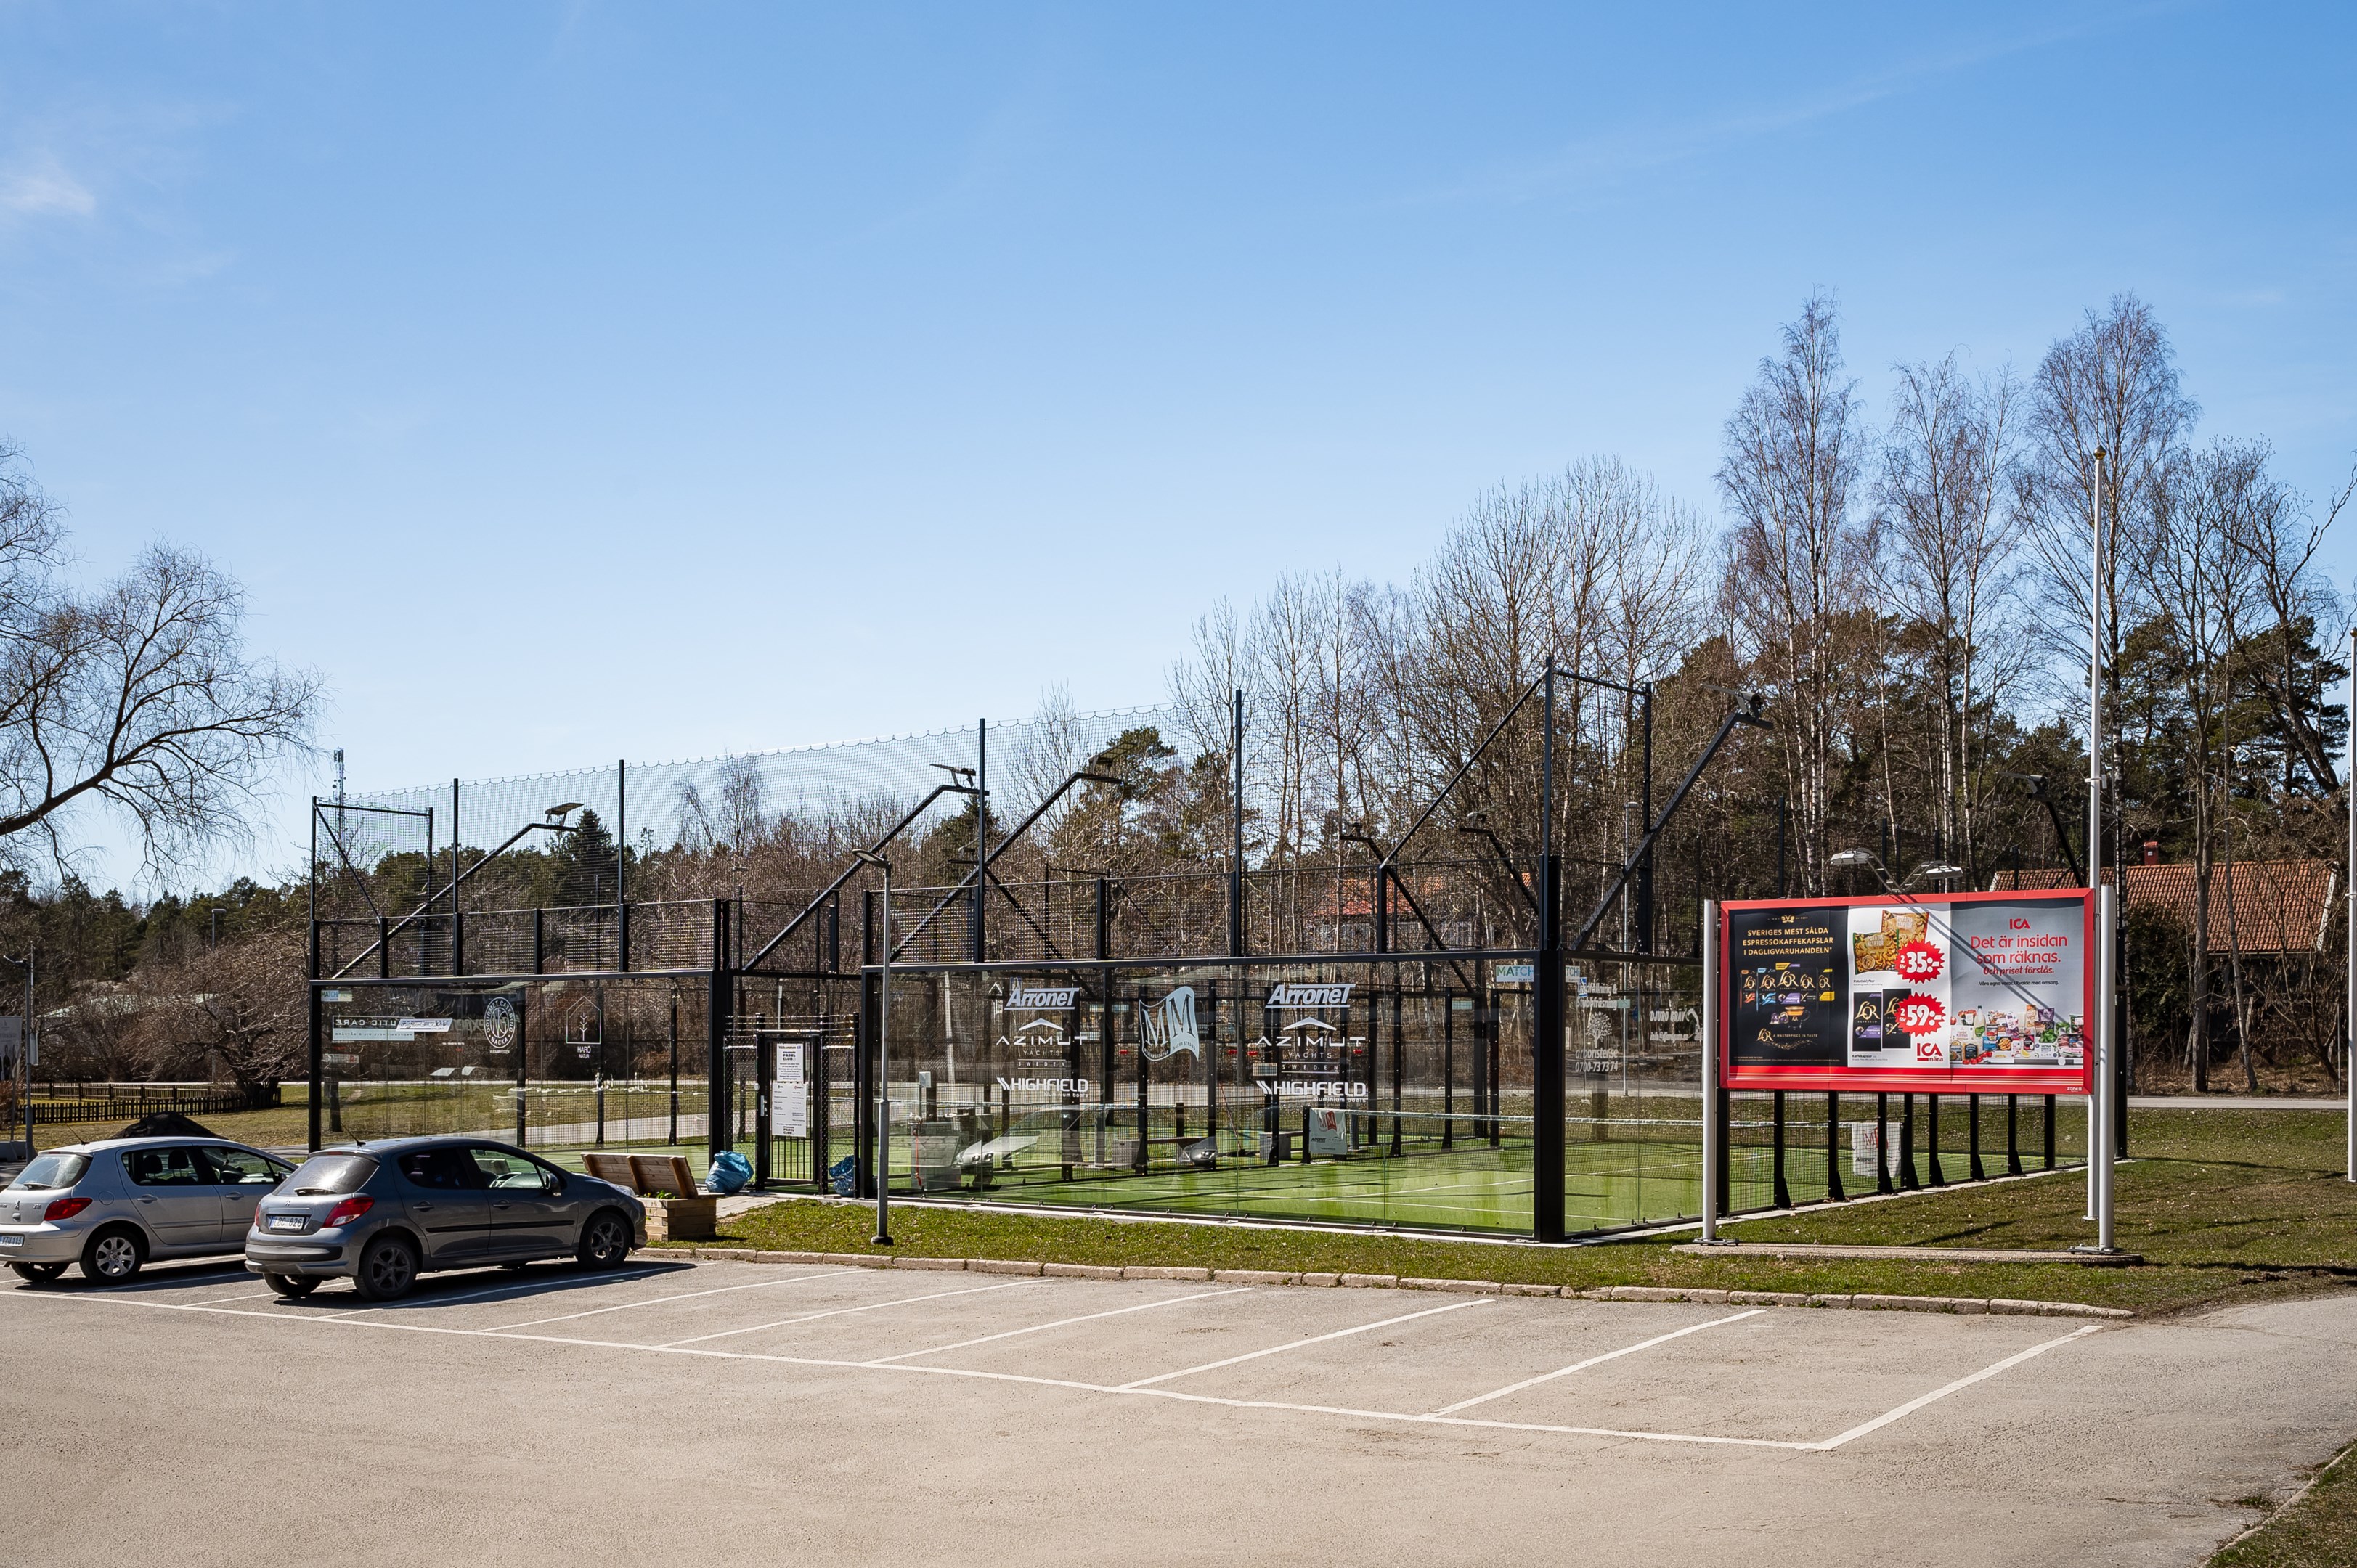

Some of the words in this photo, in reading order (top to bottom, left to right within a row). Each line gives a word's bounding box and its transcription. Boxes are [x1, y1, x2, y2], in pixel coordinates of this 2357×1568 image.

[2010, 918, 2030, 929] ICA
[1805, 926, 1828, 935] SÅLDA
[1743, 937, 1833, 946] ESPRESSOKAFFEKAPSLAR
[1971, 936, 1995, 948] Det
[1998, 935, 2013, 947] är
[2017, 934, 2067, 947] insidan
[1906, 951, 1939, 973] 35:-
[1977, 953, 2006, 964] som
[2010, 950, 2061, 963] räknas.
[1983, 966, 1998, 975] Och
[2000, 966, 2022, 976] priset
[2024, 965, 2054, 974] förstås.
[1905, 1005, 1942, 1026] 59:-
[491, 1037, 508, 1045] NACKA
[996, 1036, 1088, 1045] AZIMUT
[1255, 1036, 1366, 1047] AZIMUT
[1917, 1043, 1942, 1056] ICA
[1011, 1077, 1088, 1092] HIGHFIELD
[1274, 1081, 1367, 1097] HIGHFIELD
